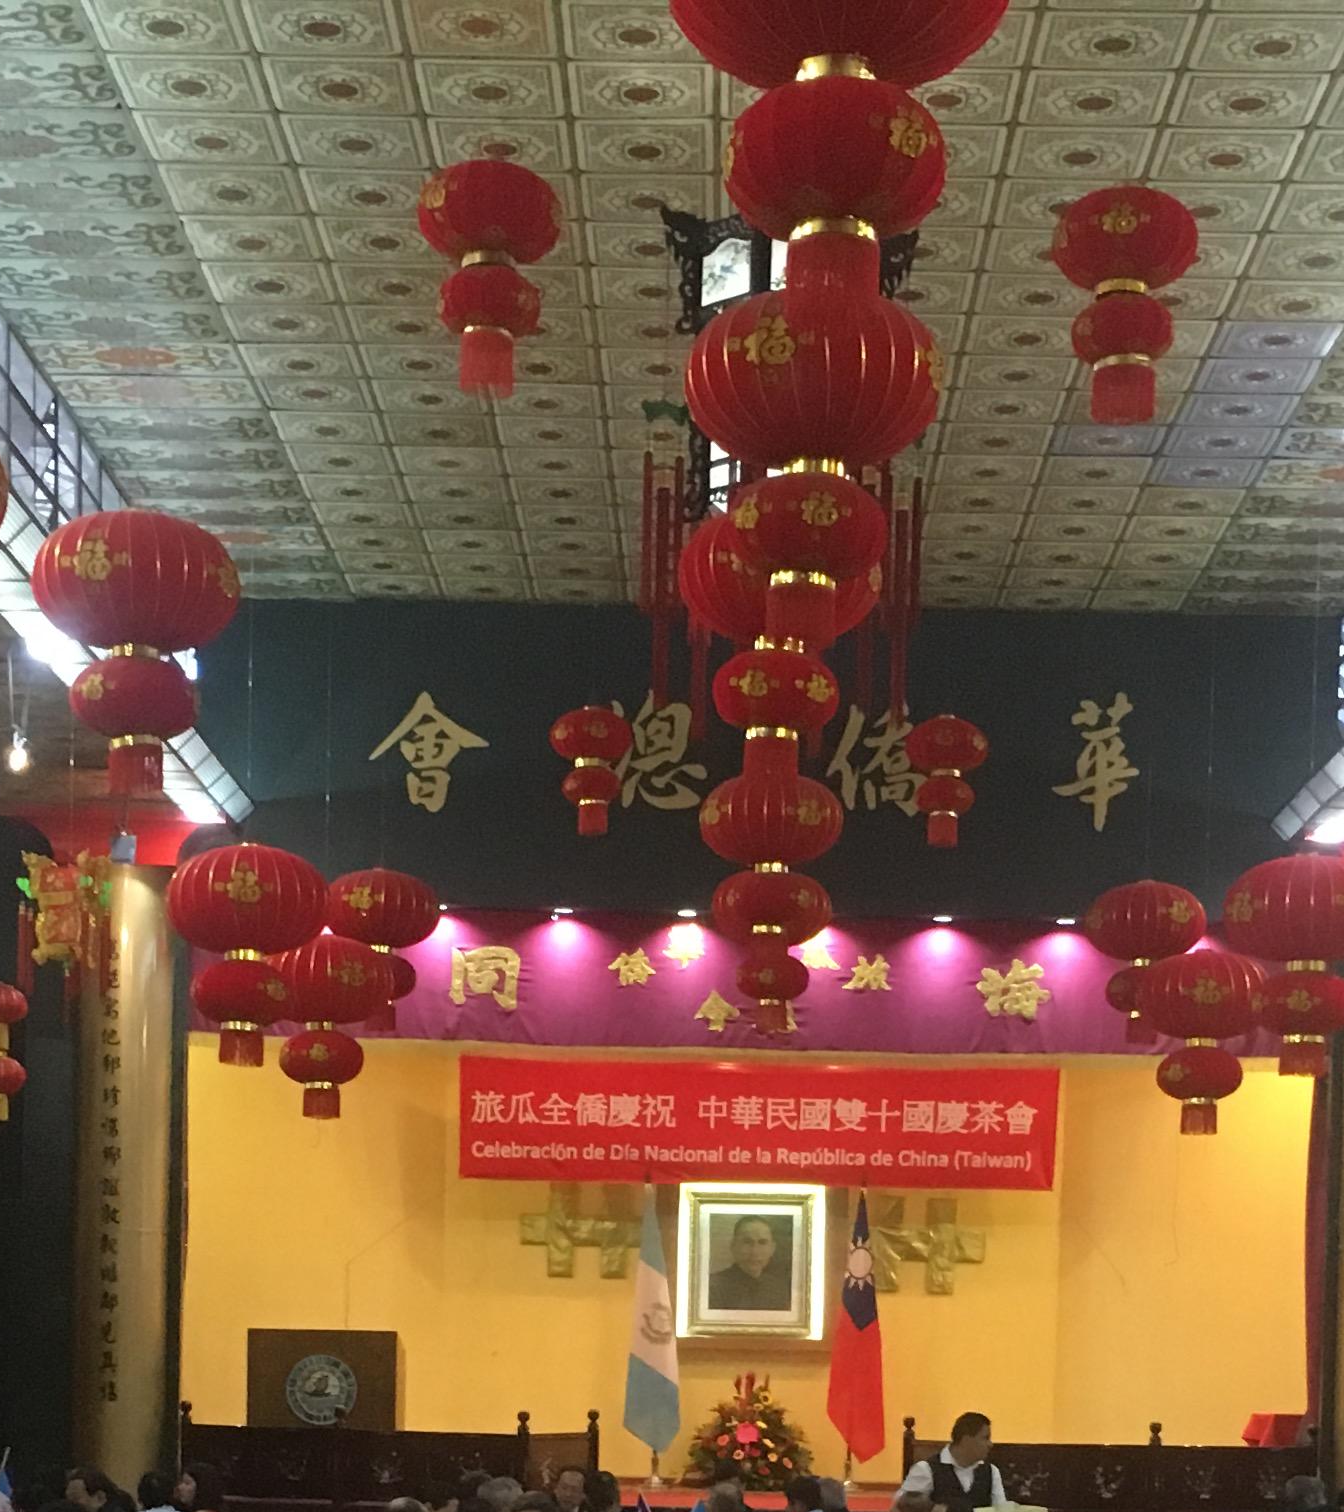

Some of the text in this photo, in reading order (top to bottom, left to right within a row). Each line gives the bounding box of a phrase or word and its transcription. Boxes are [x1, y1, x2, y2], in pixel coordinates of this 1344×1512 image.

[471, 1090, 1038, 1135] 旅瓜全僑慶祝 中華民國雙十國慶茶會
[471, 1141, 1031, 1171] Celebración de Día Nacional de la República de China (Taiwan)
